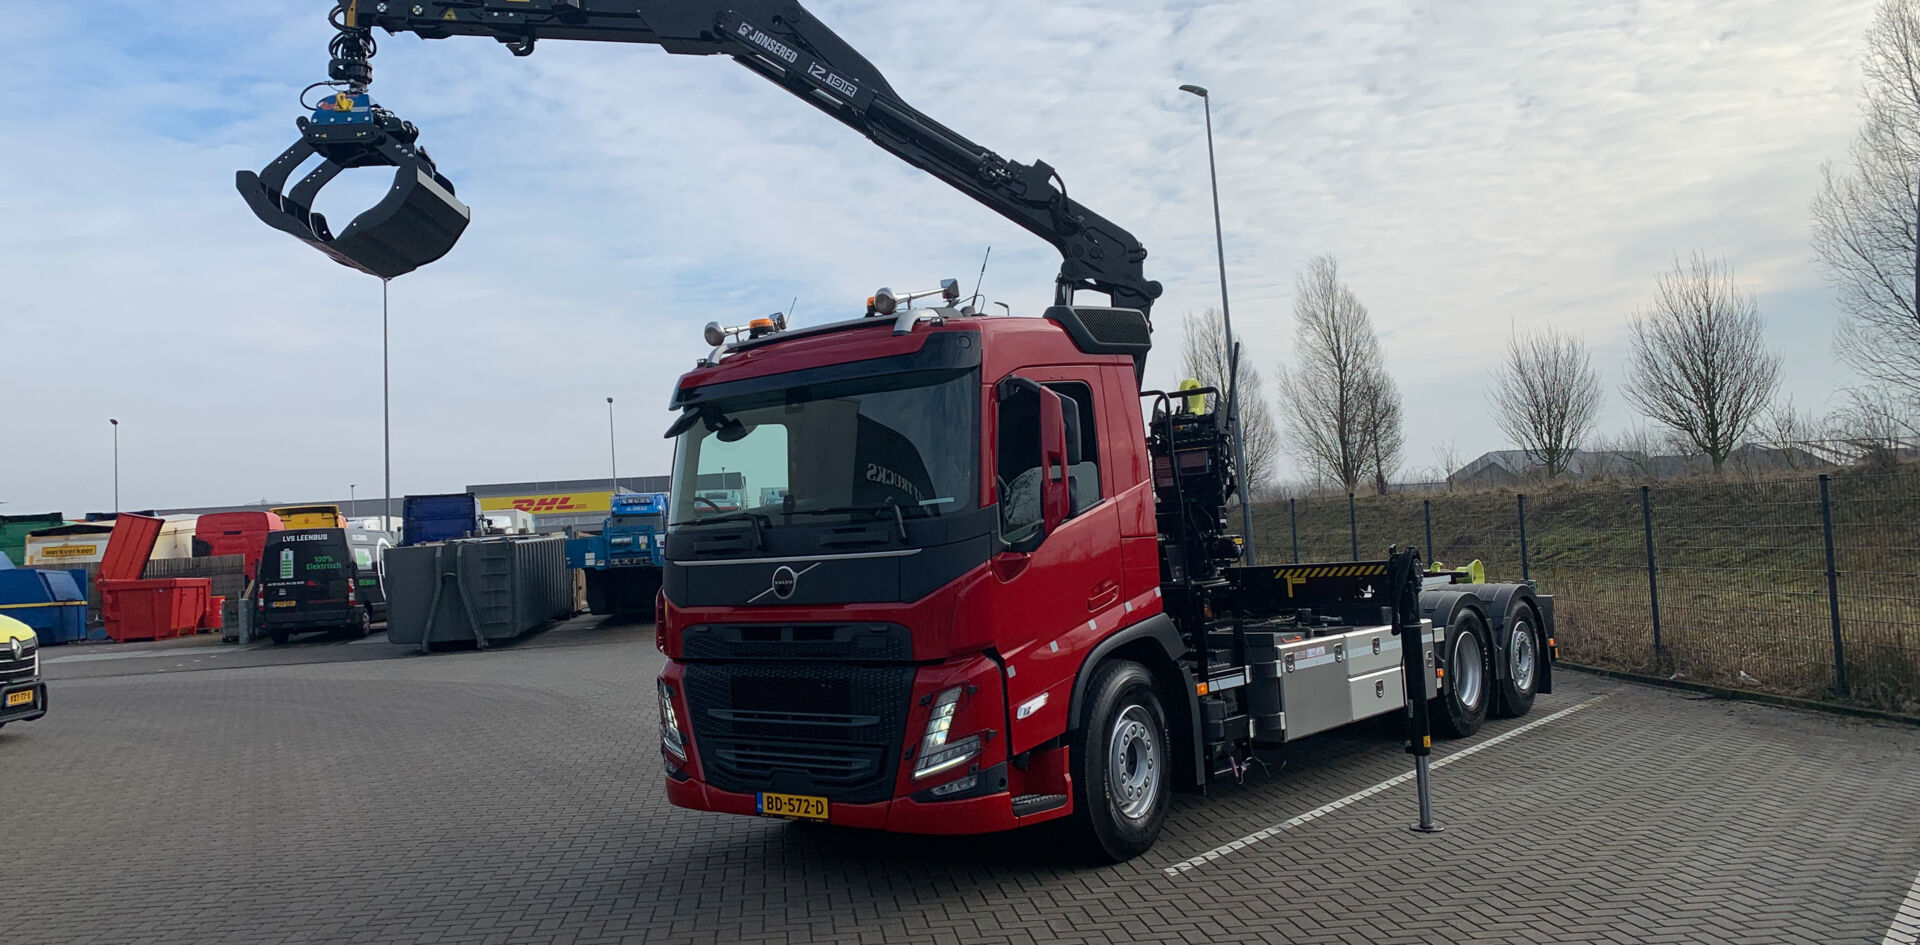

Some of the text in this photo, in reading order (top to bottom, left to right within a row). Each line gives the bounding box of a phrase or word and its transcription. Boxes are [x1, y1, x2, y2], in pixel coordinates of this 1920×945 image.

[749, 31, 798, 63] JONSERED
[512, 497, 575, 511] DHL
[296, 533, 328, 541] LEENBUS
[766, 796, 824, 815] BD-572-D
